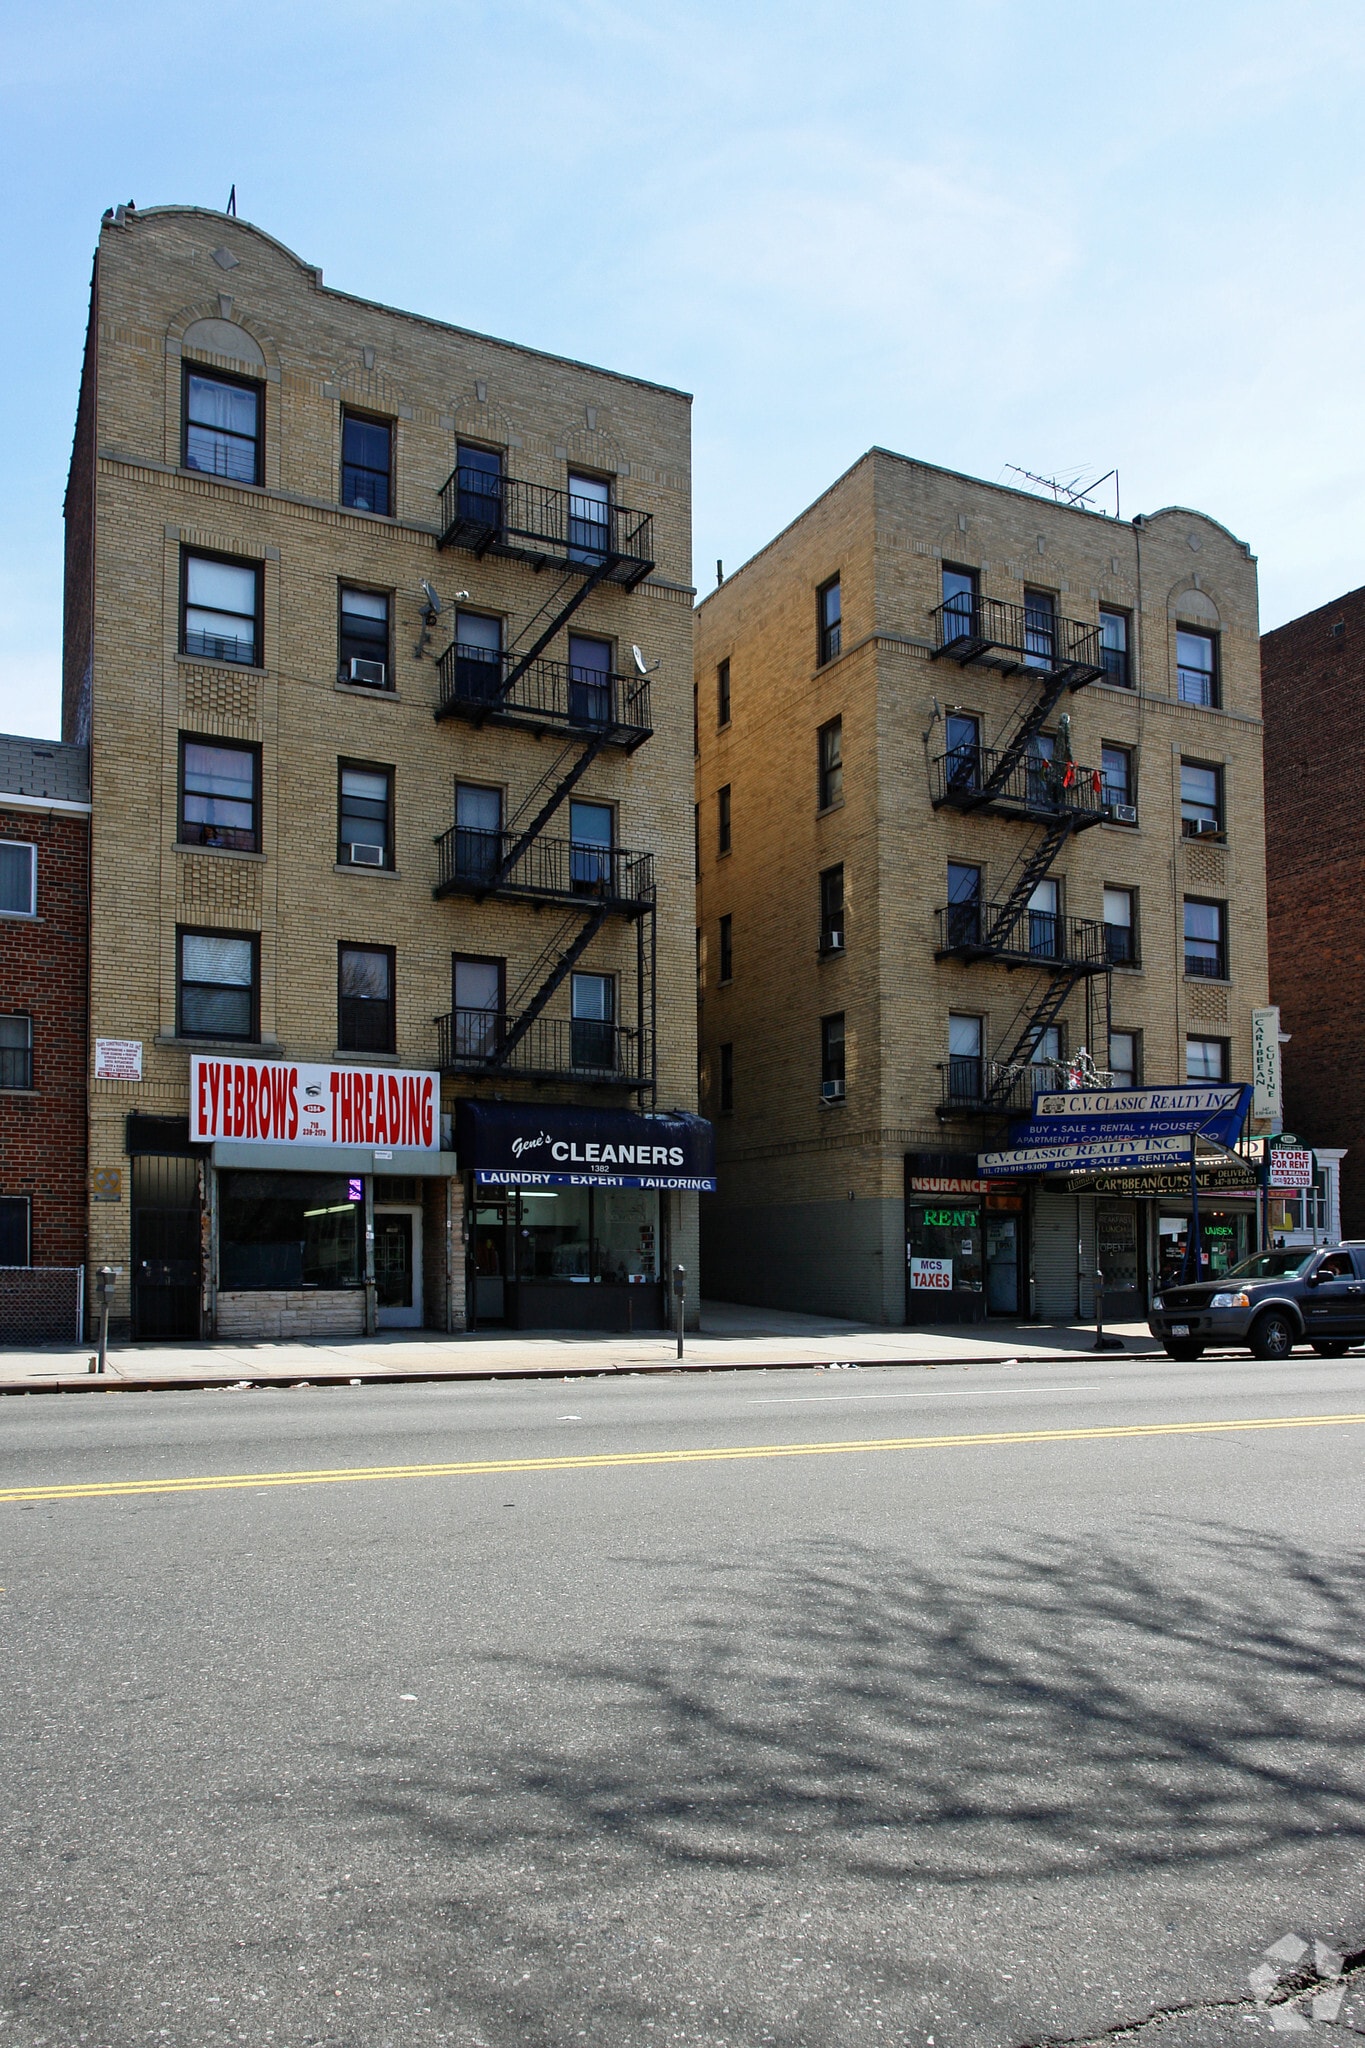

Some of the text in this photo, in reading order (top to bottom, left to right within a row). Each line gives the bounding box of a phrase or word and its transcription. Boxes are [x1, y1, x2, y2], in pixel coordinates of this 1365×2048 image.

[1255, 1018, 1265, 1086] CARIBBEAN
[1266, 1045, 1275, 1097] CUISINE
[198, 1062, 298, 1141] EYEBROWS
[330, 1071, 433, 1147] THREADING
[1069, 1092, 1234, 1112] C.V. CLASSIC REALTY INC.
[1029, 1122, 1201, 1133] BUY SALE RENTAL HOUSES
[511, 1130, 553, 1158] Gene's
[1016, 1136, 1070, 1144] APARTMENT
[551, 1142, 684, 1166] CLEANERS
[984, 1138, 1180, 1165] C.V. CLASSIC REALTY INC.
[1272, 1151, 1309, 1160] STORE
[1054, 1160, 1076, 1168] BUY
[1090, 1157, 1121, 1166] SALE
[1137, 1153, 1182, 1163] RENTAL
[1271, 1160, 1309, 1169] FOR RENT
[590, 1165, 610, 1173] 1382
[1218, 1169, 1251, 1177] DELIVERY
[481, 1172, 712, 1190] LAUNDRY EXPERT TAILORING
[1160, 1174, 1210, 1188] CUISNE
[923, 1209, 980, 1227] RENT
[1101, 1225, 1126, 1233] LUNCH
[1204, 1226, 1233, 1235] UNISEX
[1100, 1243, 1125, 1252] OPEN
[920, 1260, 942, 1270] MCS
[913, 1273, 950, 1288] TAXES
